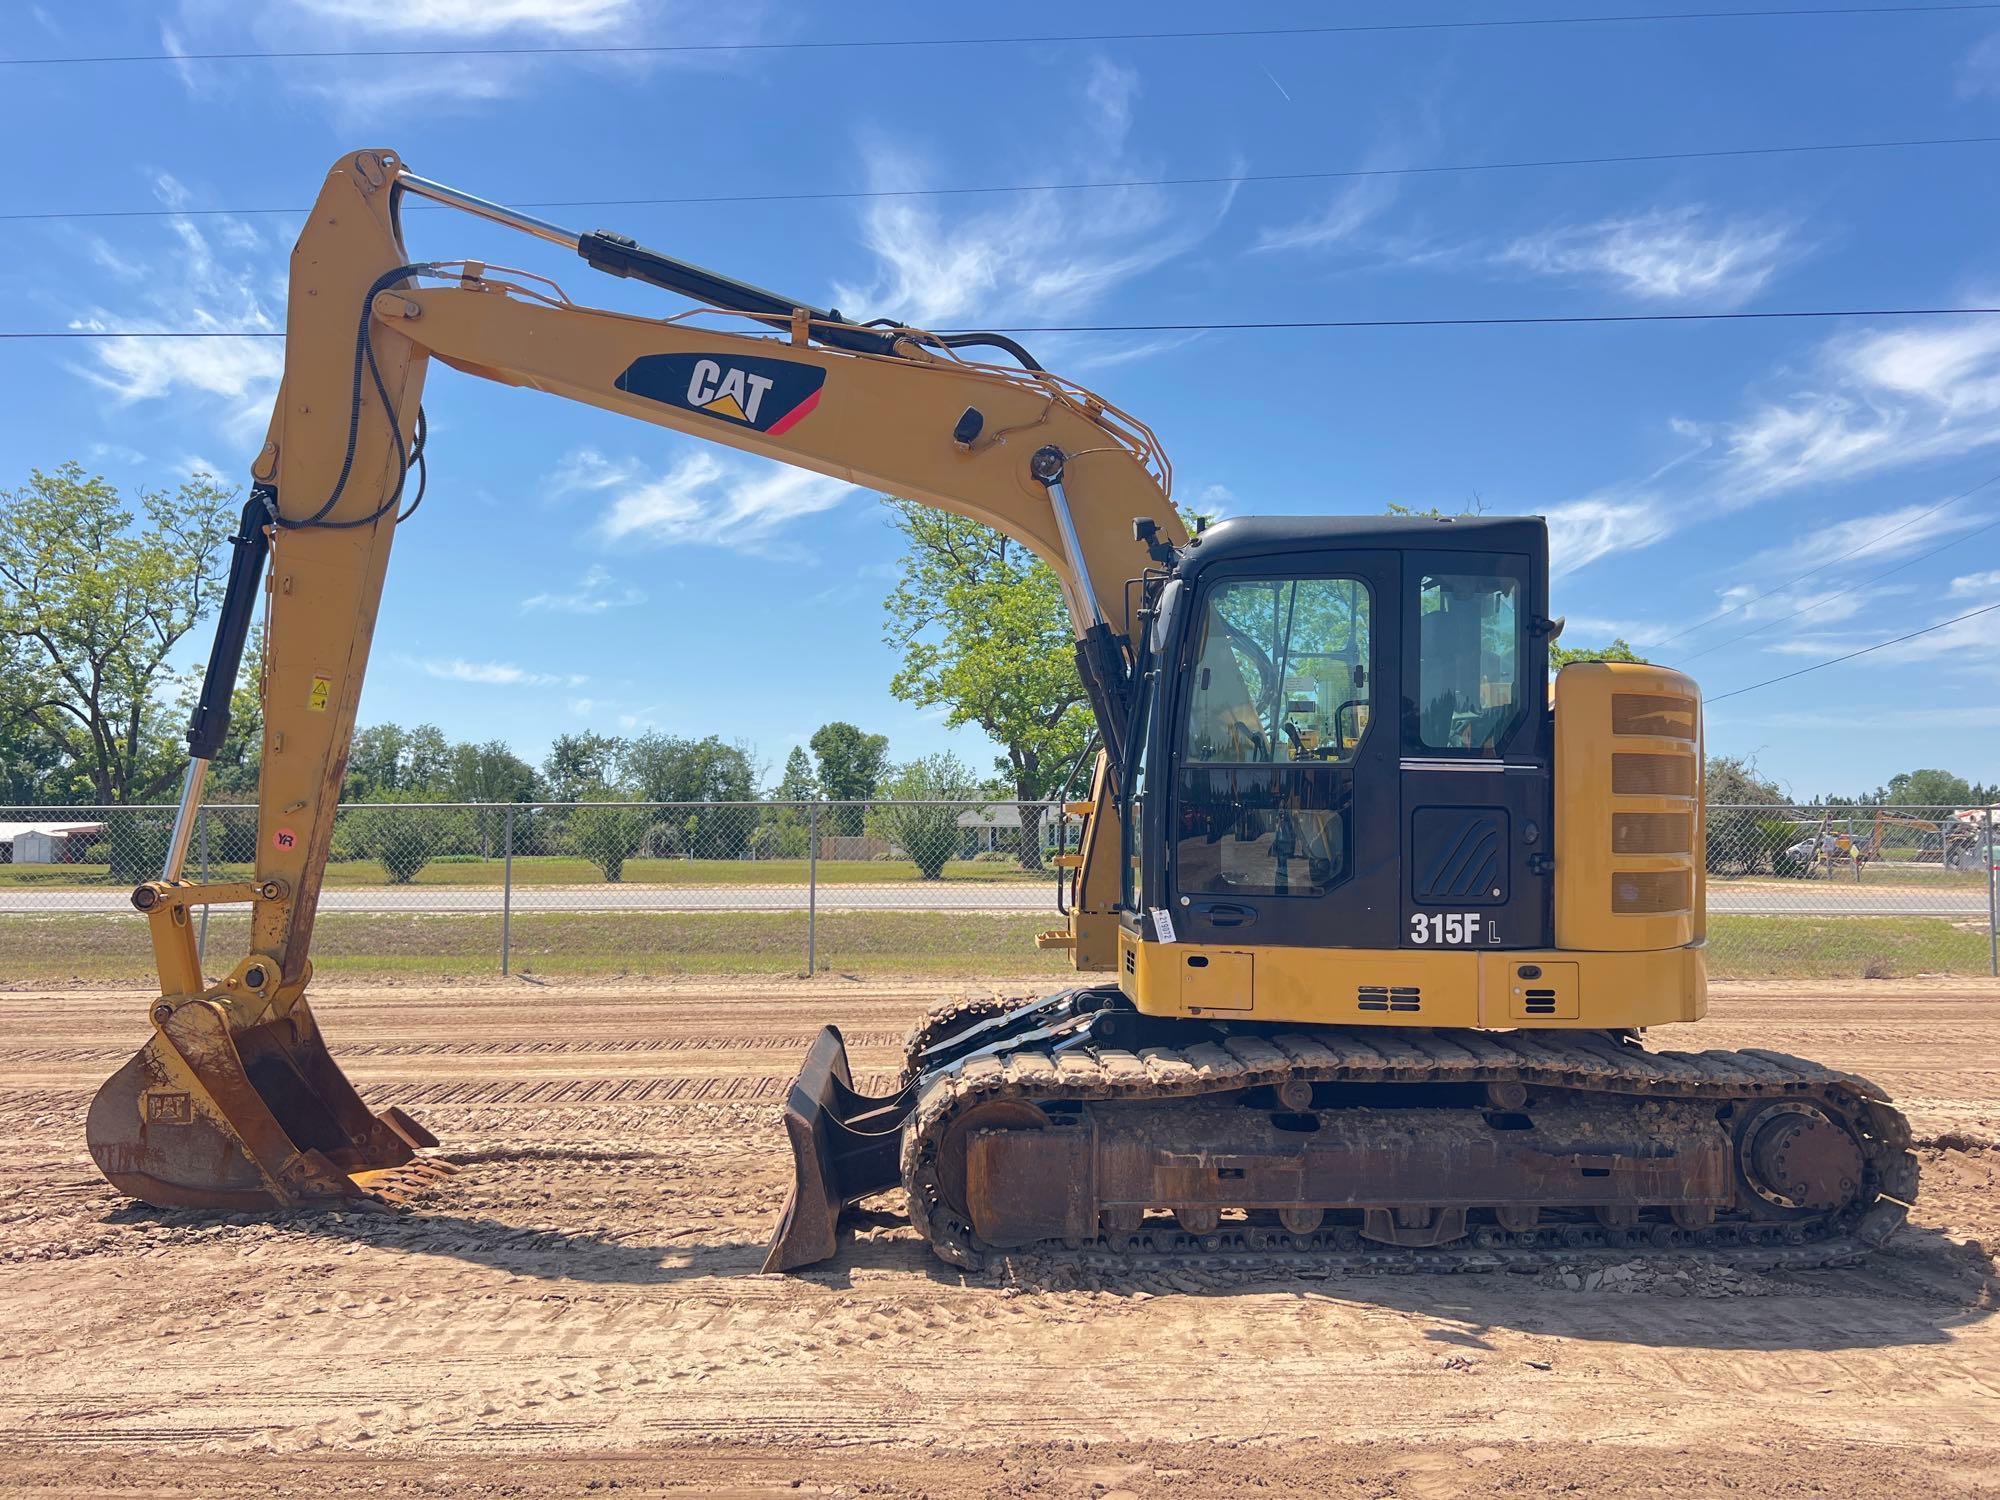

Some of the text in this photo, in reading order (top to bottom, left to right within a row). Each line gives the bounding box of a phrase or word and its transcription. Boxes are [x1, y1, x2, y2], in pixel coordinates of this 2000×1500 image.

[687, 359, 774, 423] CAT
[278, 832, 294, 847] YR
[1410, 913, 1501, 944] 315F L
